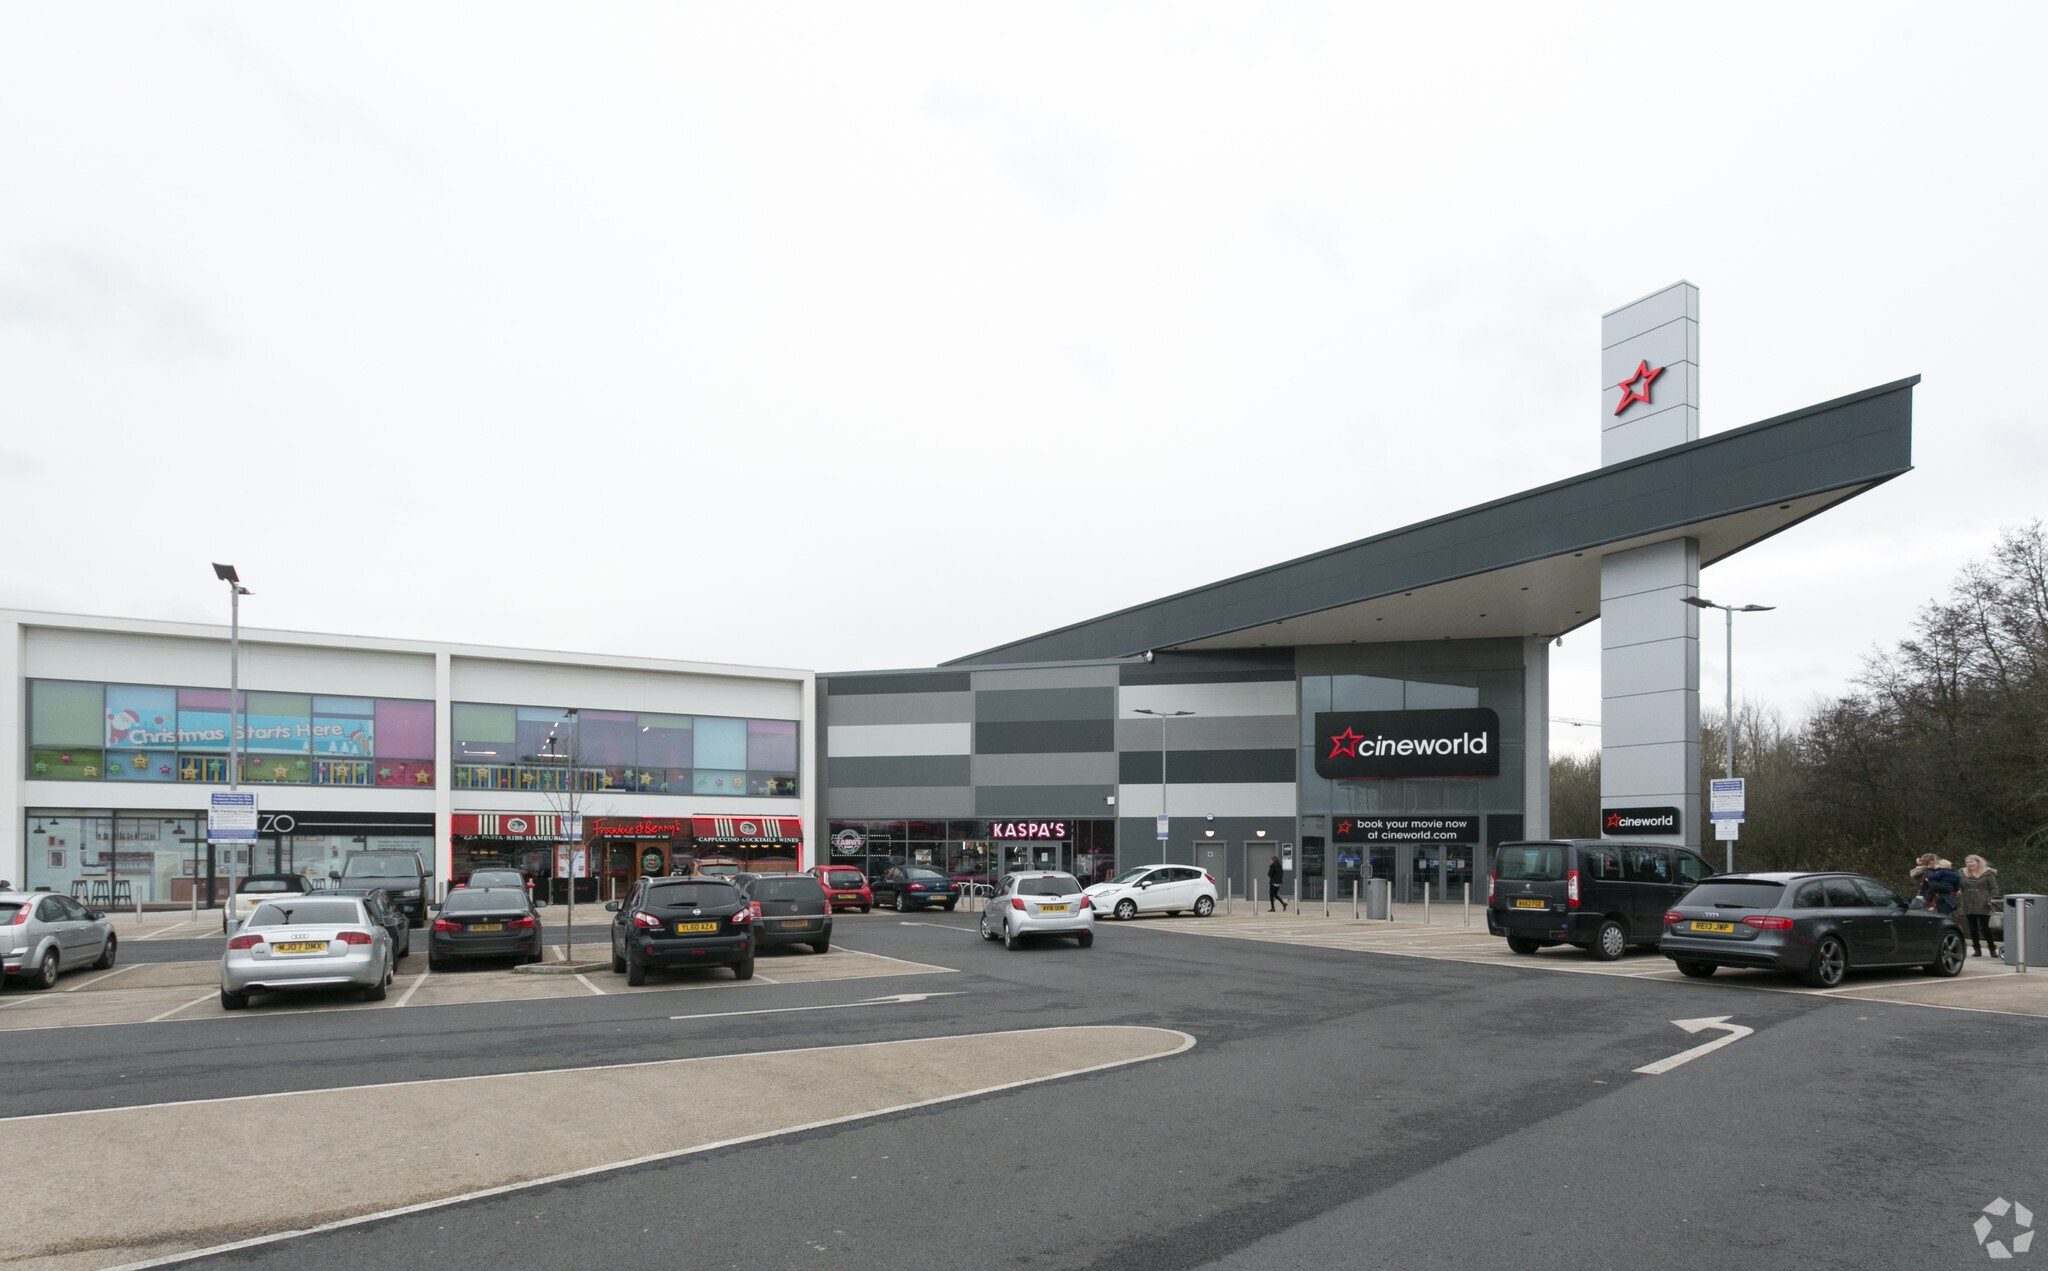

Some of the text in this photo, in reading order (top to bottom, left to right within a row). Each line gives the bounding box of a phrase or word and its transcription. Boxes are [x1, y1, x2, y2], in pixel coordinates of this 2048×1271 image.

[128, 722, 343, 746] Christmas Starts Here
[1358, 731, 1487, 756] cineworld
[257, 814, 295, 832] ZO
[593, 817, 634, 837] Frankie
[644, 819, 681, 837] Benny's
[1357, 819, 1467, 830] book your movie now
[1618, 815, 1673, 826] cineworld
[993, 822, 1065, 837] KASPA'S
[1367, 831, 1457, 839] at cineworld.com
[701, 922, 714, 930] AZA
[1696, 922, 1712, 930] RE13
